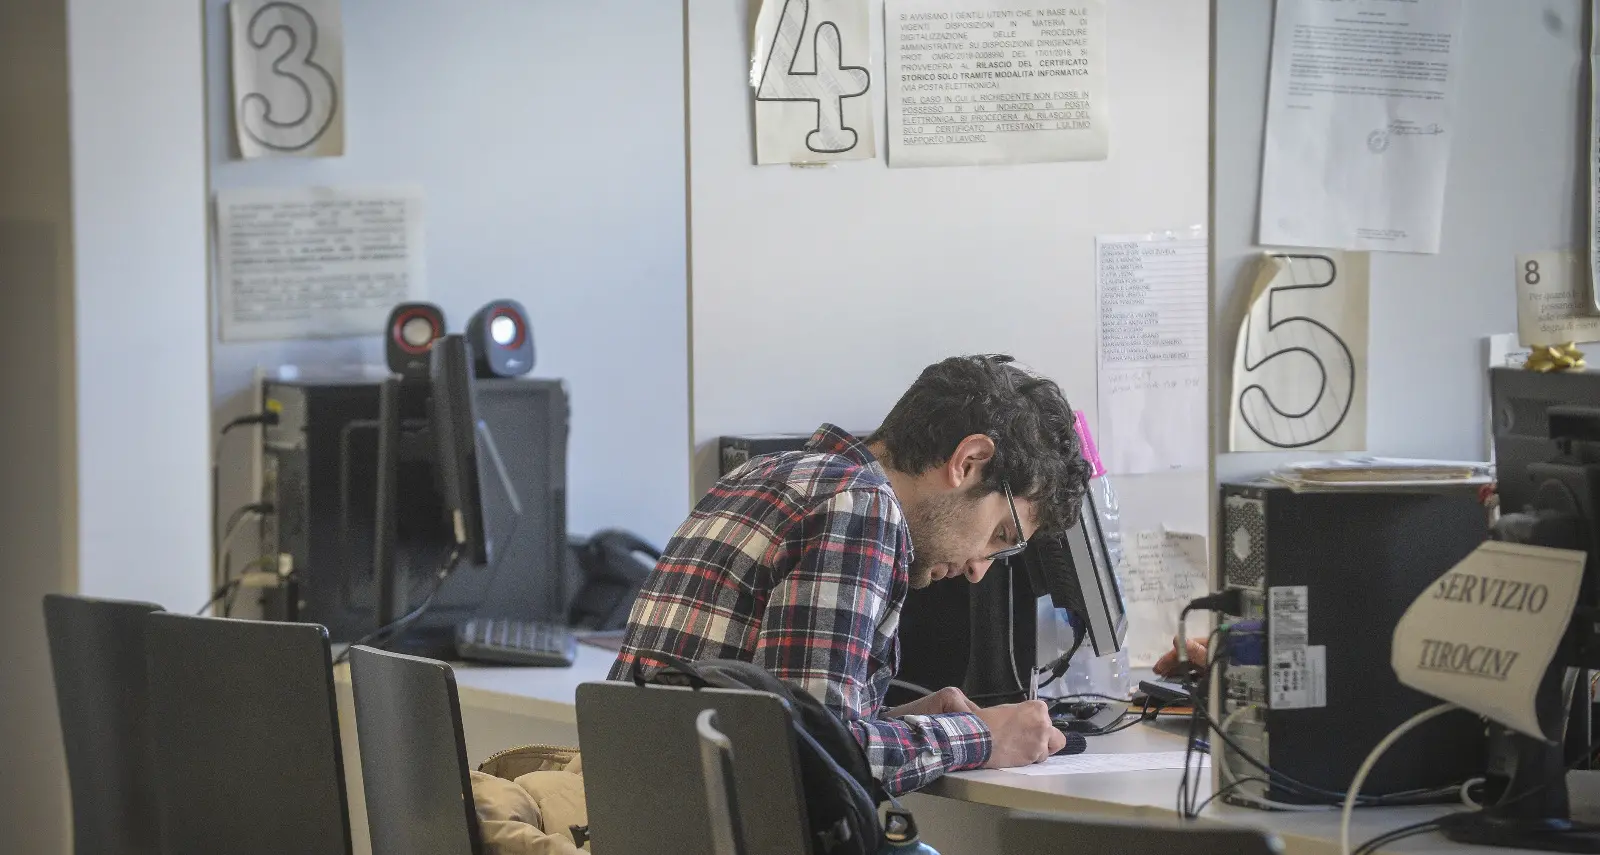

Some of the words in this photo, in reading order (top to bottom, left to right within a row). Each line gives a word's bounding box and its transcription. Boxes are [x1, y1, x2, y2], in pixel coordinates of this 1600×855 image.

[987, 10, 1014, 18] UTENTI
[945, 21, 994, 29] DISPOSIZIONI
[900, 32, 968, 40] DIGITALIZZAZIONE
[983, 40, 1035, 48] DISPOSIZIONE
[1040, 59, 1088, 67] CERTIFICATO
[241, 1, 338, 152] 3
[756, 0, 871, 153] 4
[901, 73, 936, 81] STORICO
[994, 70, 1036, 78] MODALITA'
[980, 92, 1031, 101] RICHIEDENTE
[1034, 92, 1051, 100] NON
[1054, 91, 1079, 100] FOSSE
[902, 106, 943, 114] POSSESSO
[975, 104, 985, 112] UN
[997, 102, 1034, 110] INDIRIZZO
[1065, 101, 1090, 109] POSTA
[996, 123, 1044, 131] ATTESTANTE
[1524, 260, 1541, 285] 8
[1240, 254, 1355, 448] 5
[1433, 573, 1549, 614] SERVIZIO
[1418, 639, 1519, 680] TIROCINI
